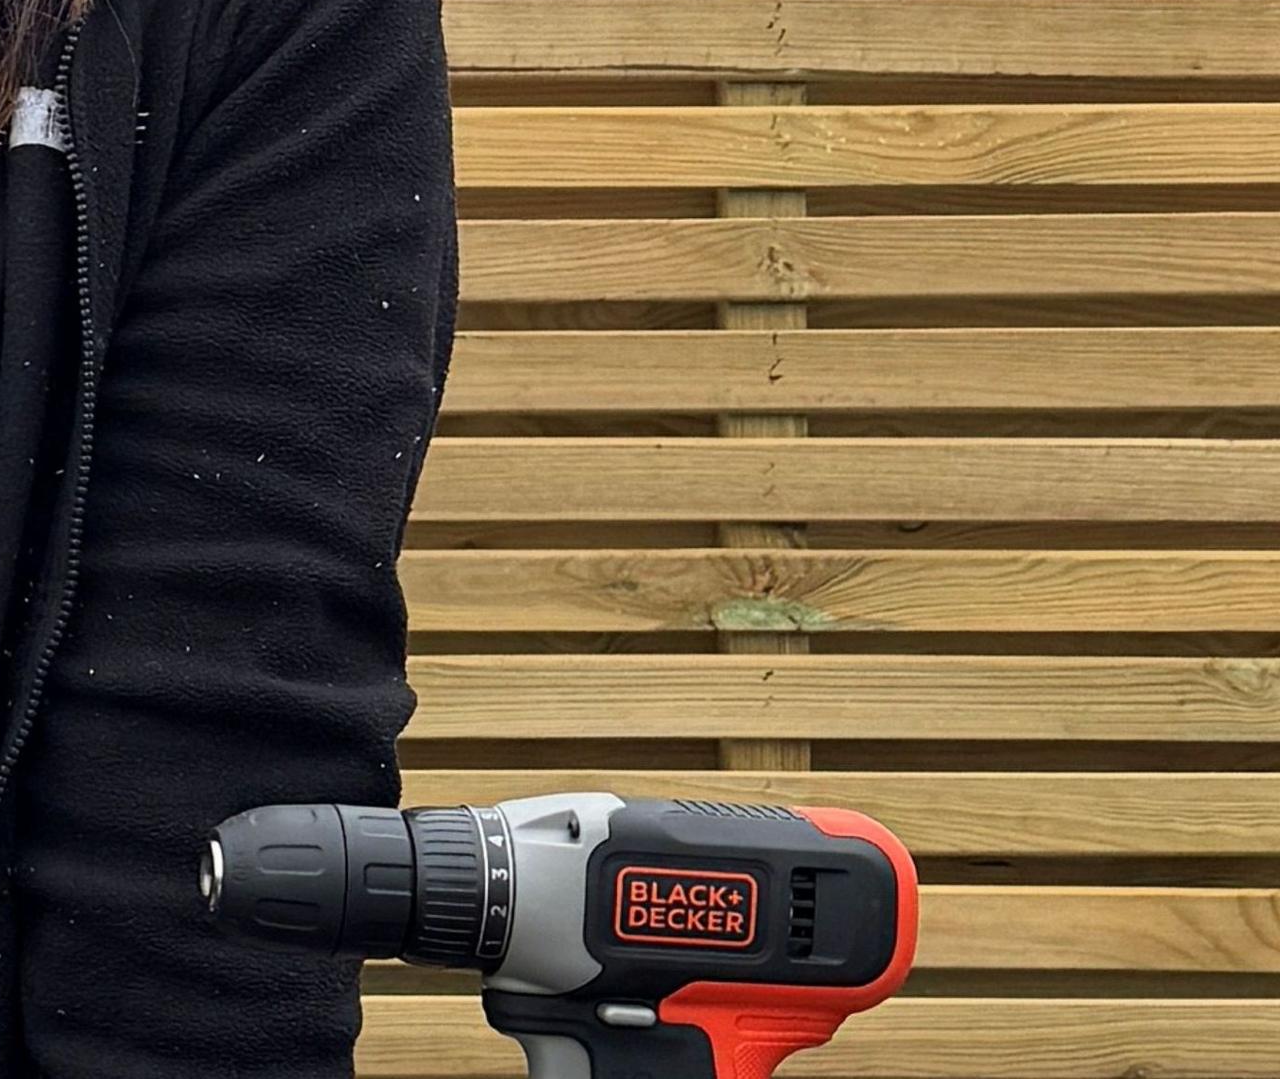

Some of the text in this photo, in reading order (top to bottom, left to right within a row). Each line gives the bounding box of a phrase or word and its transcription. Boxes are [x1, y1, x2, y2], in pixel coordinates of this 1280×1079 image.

[487, 834, 504, 848] 4
[491, 867, 508, 881] 3
[629, 880, 744, 908] BLACK+
[490, 904, 507, 918] 2
[628, 905, 744, 934] DECKER
